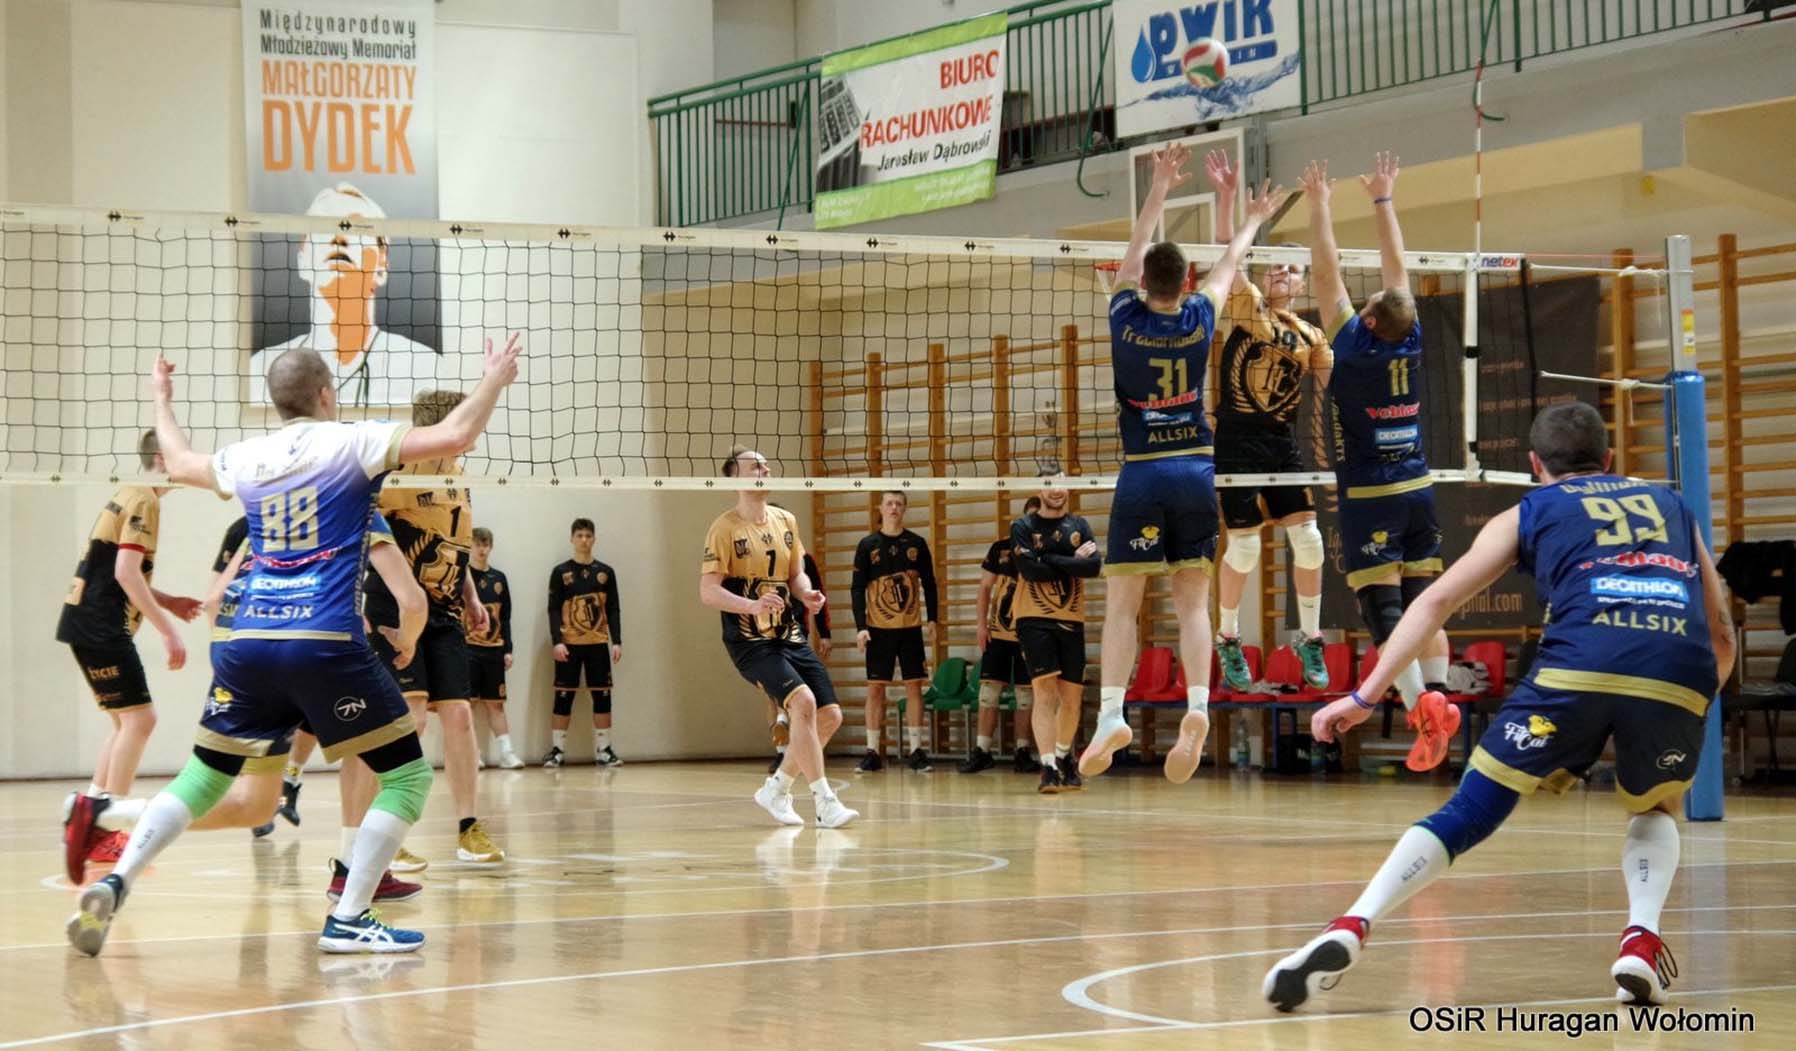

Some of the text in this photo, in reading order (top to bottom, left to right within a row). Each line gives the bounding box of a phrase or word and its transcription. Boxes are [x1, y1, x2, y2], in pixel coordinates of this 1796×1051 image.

[260, 9, 416, 38] Międzynarodowy
[261, 34, 417, 60] Młodzieżowy Memoriał
[262, 59, 417, 100] MAŁGORZATY
[940, 50, 999, 88] BIURO
[262, 99, 416, 175] DYDEK
[878, 130, 991, 171] Jarosław Dąbrowski
[1149, 357, 1187, 403] 31
[1387, 358, 1409, 396] 11
[1147, 426, 1199, 445] ALLSIX
[260, 485, 319, 552] 88
[450, 505, 462, 538] 1
[1580, 493, 1669, 546] 99
[243, 604, 314, 620] ALLSIX
[1592, 611, 1688, 637] ALLSIX
